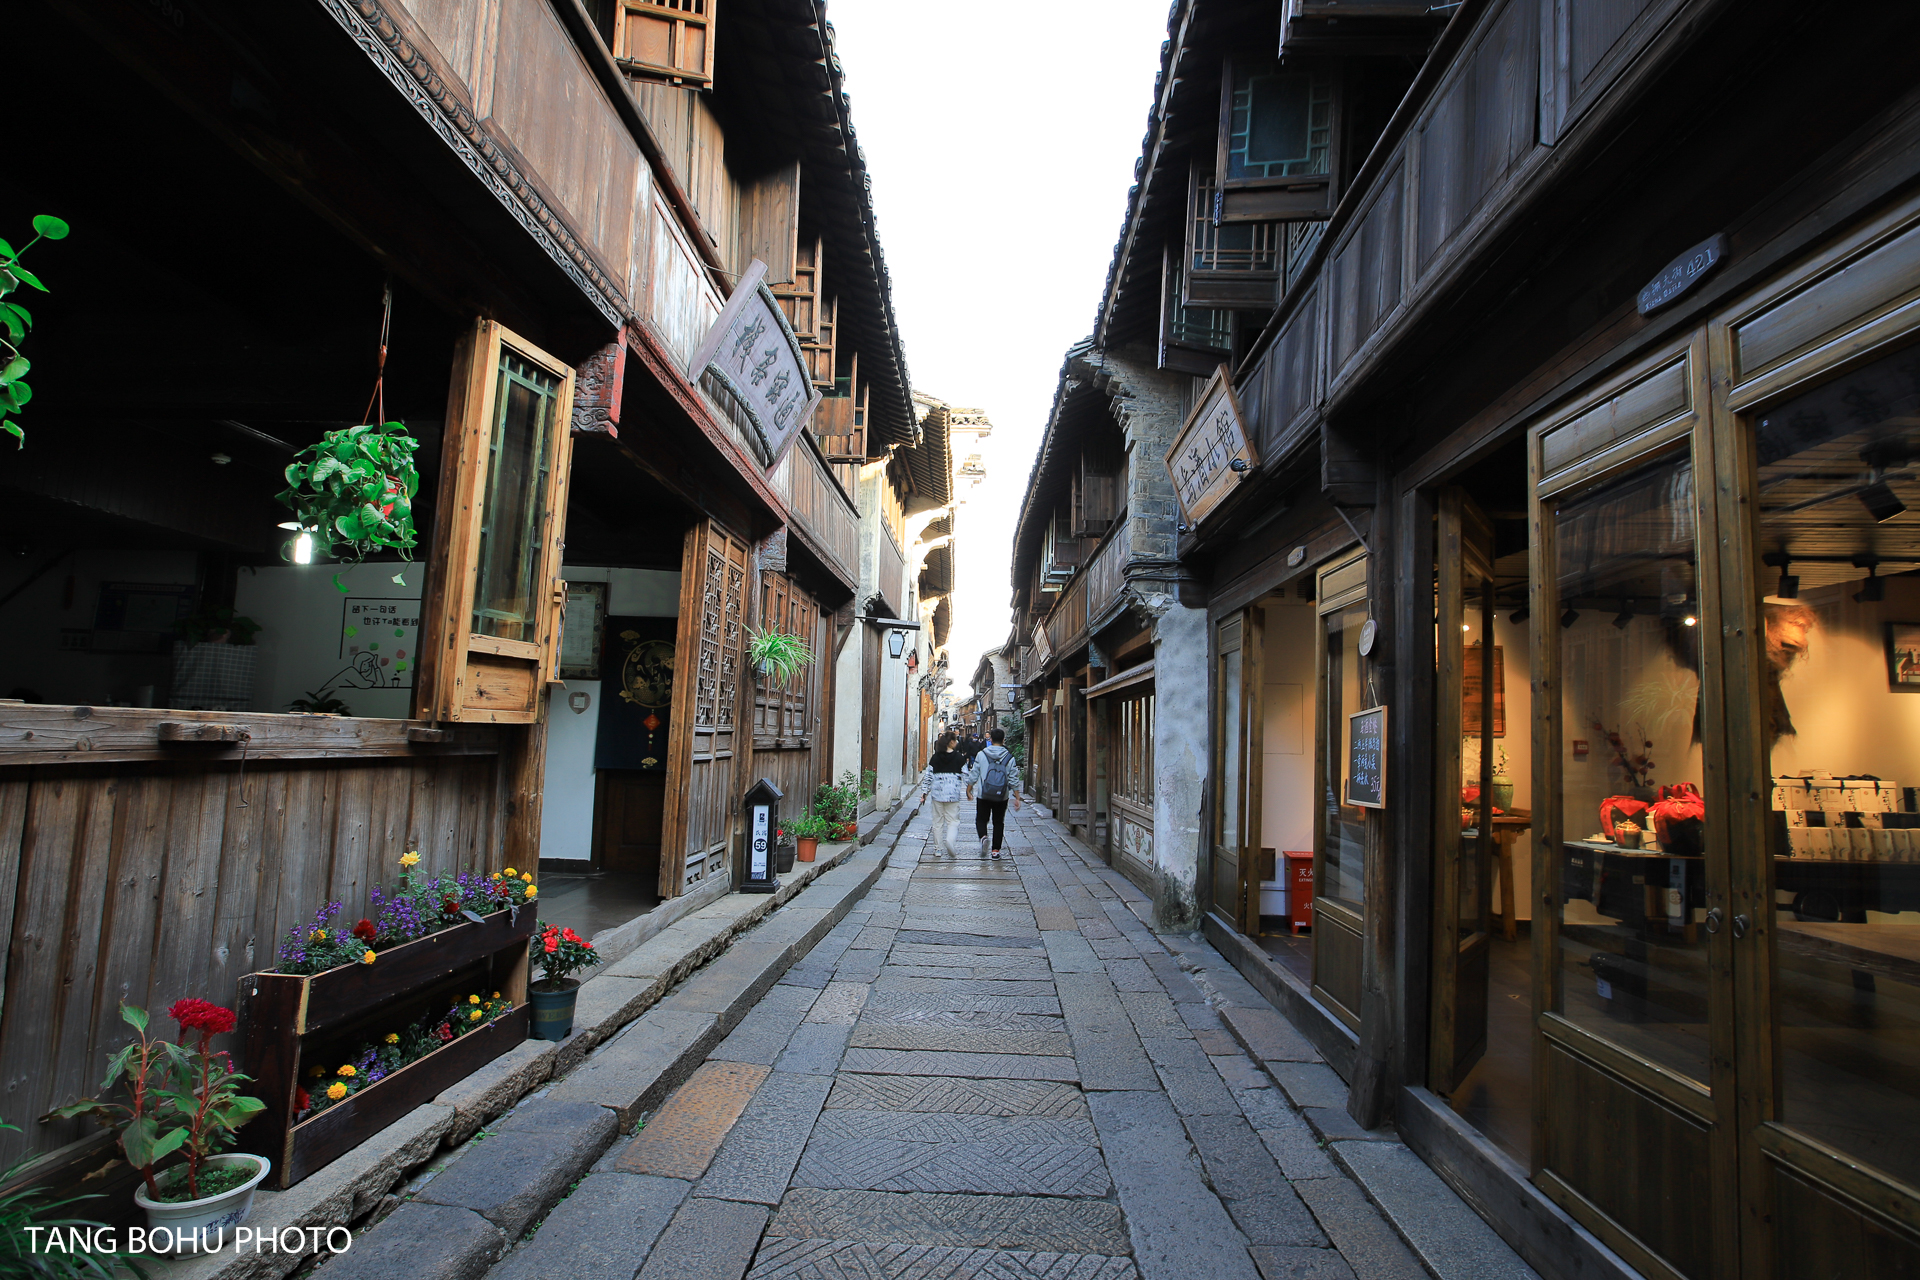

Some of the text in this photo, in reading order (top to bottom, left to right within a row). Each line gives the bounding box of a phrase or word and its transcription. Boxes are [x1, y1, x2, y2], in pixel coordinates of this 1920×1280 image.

[1686, 248, 1715, 278] 421
[351, 605, 397, 614] 留下一句话
[755, 841, 767, 850] 59
